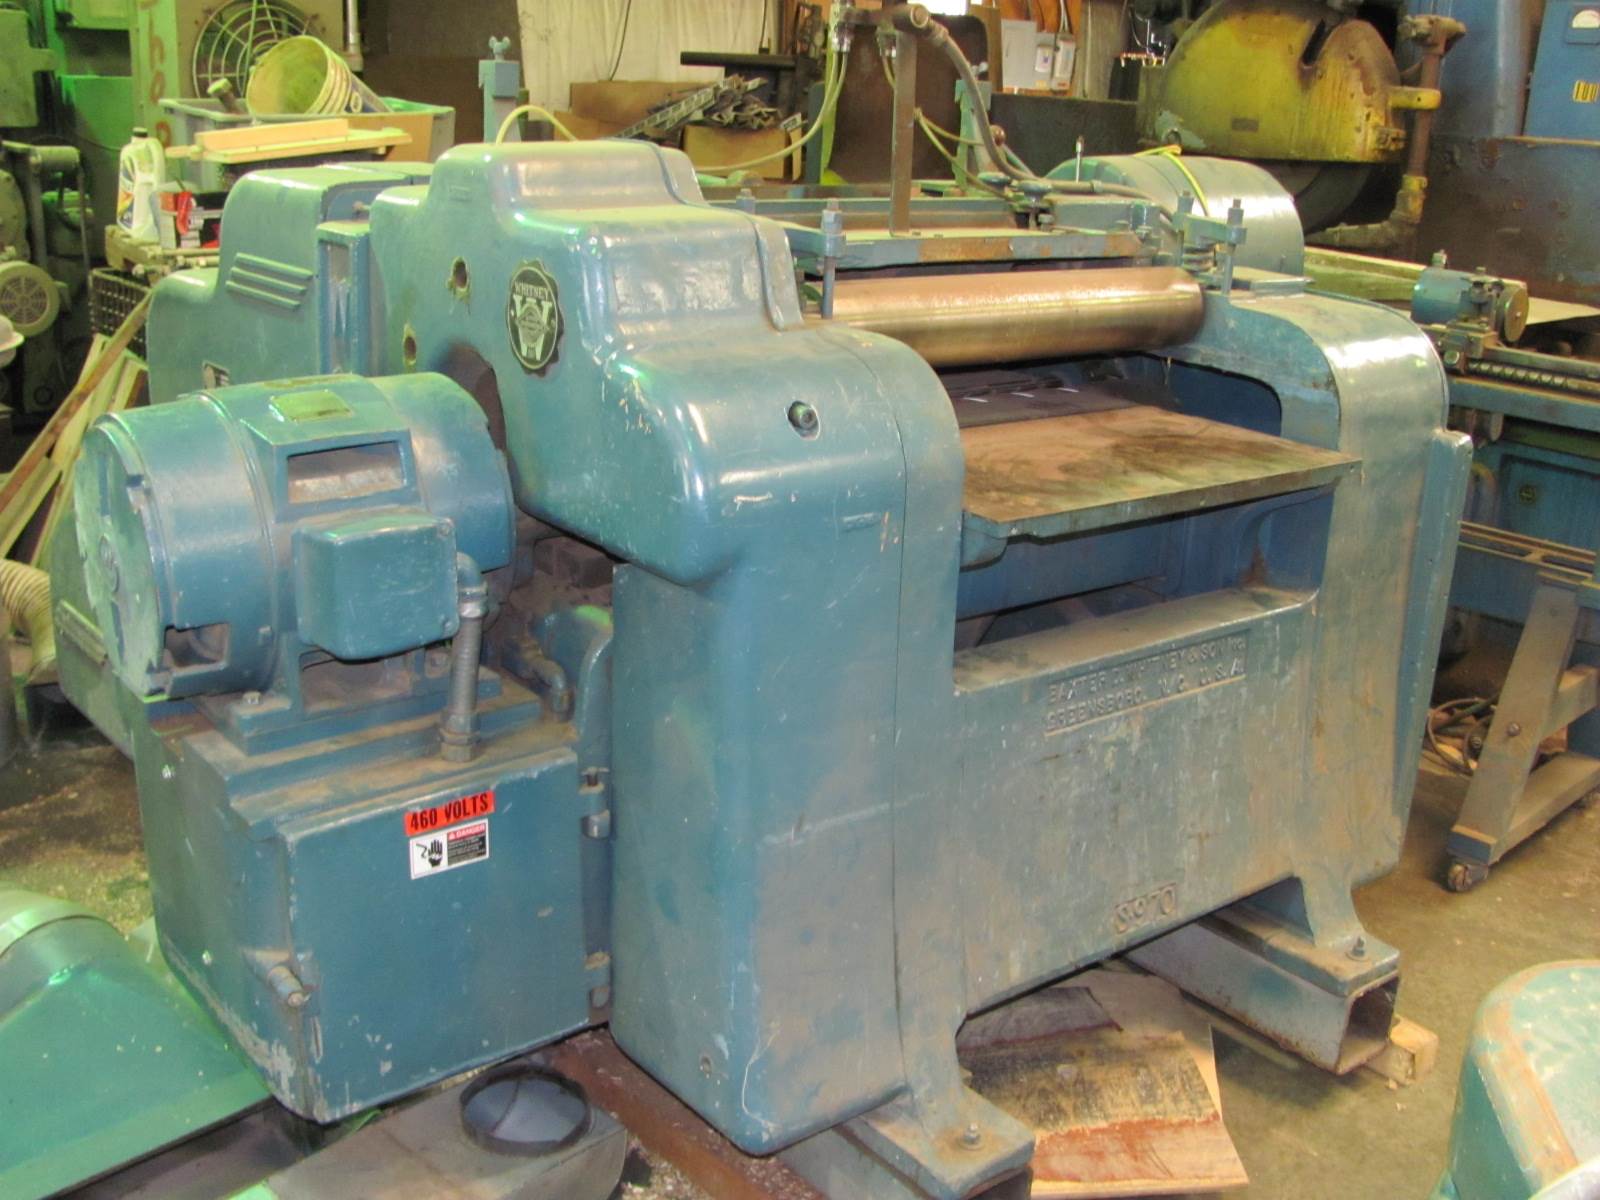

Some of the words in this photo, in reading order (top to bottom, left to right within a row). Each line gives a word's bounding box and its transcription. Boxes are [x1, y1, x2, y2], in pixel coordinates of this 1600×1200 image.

[514, 281, 549, 301] WHITNEY
[410, 808, 438, 830] 460
[445, 793, 489, 822] VOLTS
